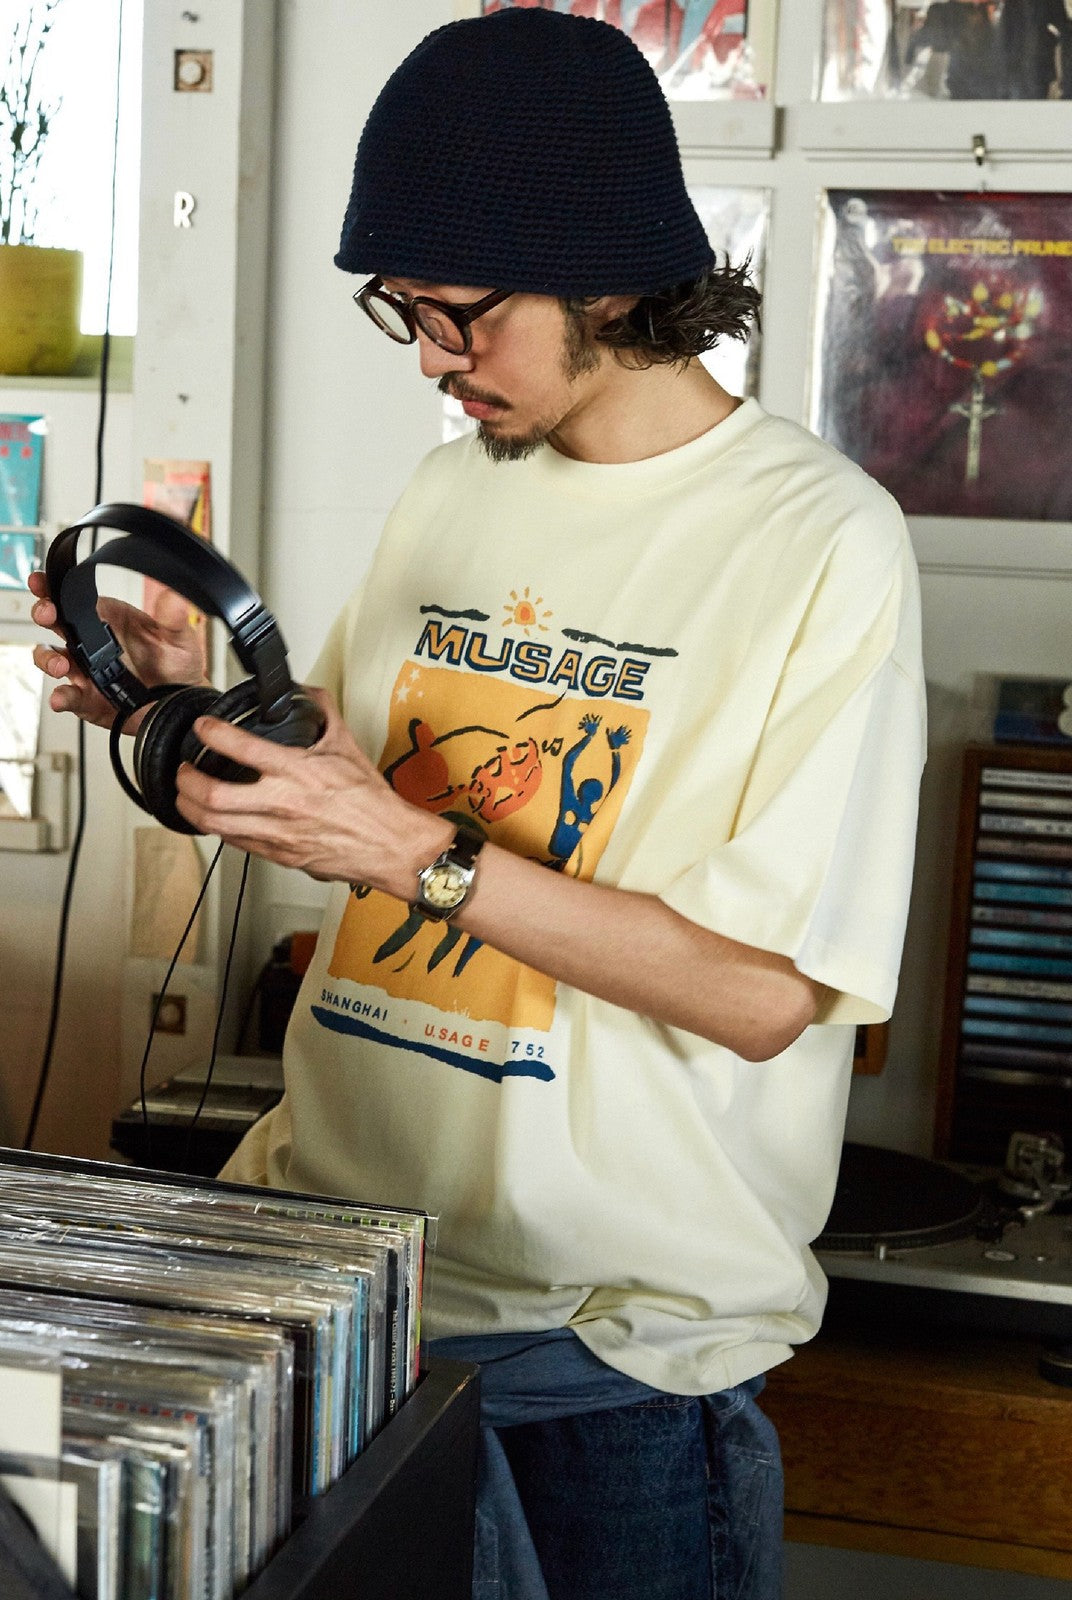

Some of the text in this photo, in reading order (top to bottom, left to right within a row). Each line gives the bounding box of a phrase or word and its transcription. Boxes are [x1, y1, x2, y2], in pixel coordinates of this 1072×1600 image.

[173, 190, 196, 228] R
[927, 238, 1010, 254] ELECTRIC
[414, 620, 651, 701] MUSAGE
[320, 988, 389, 1022] SHANGHAI
